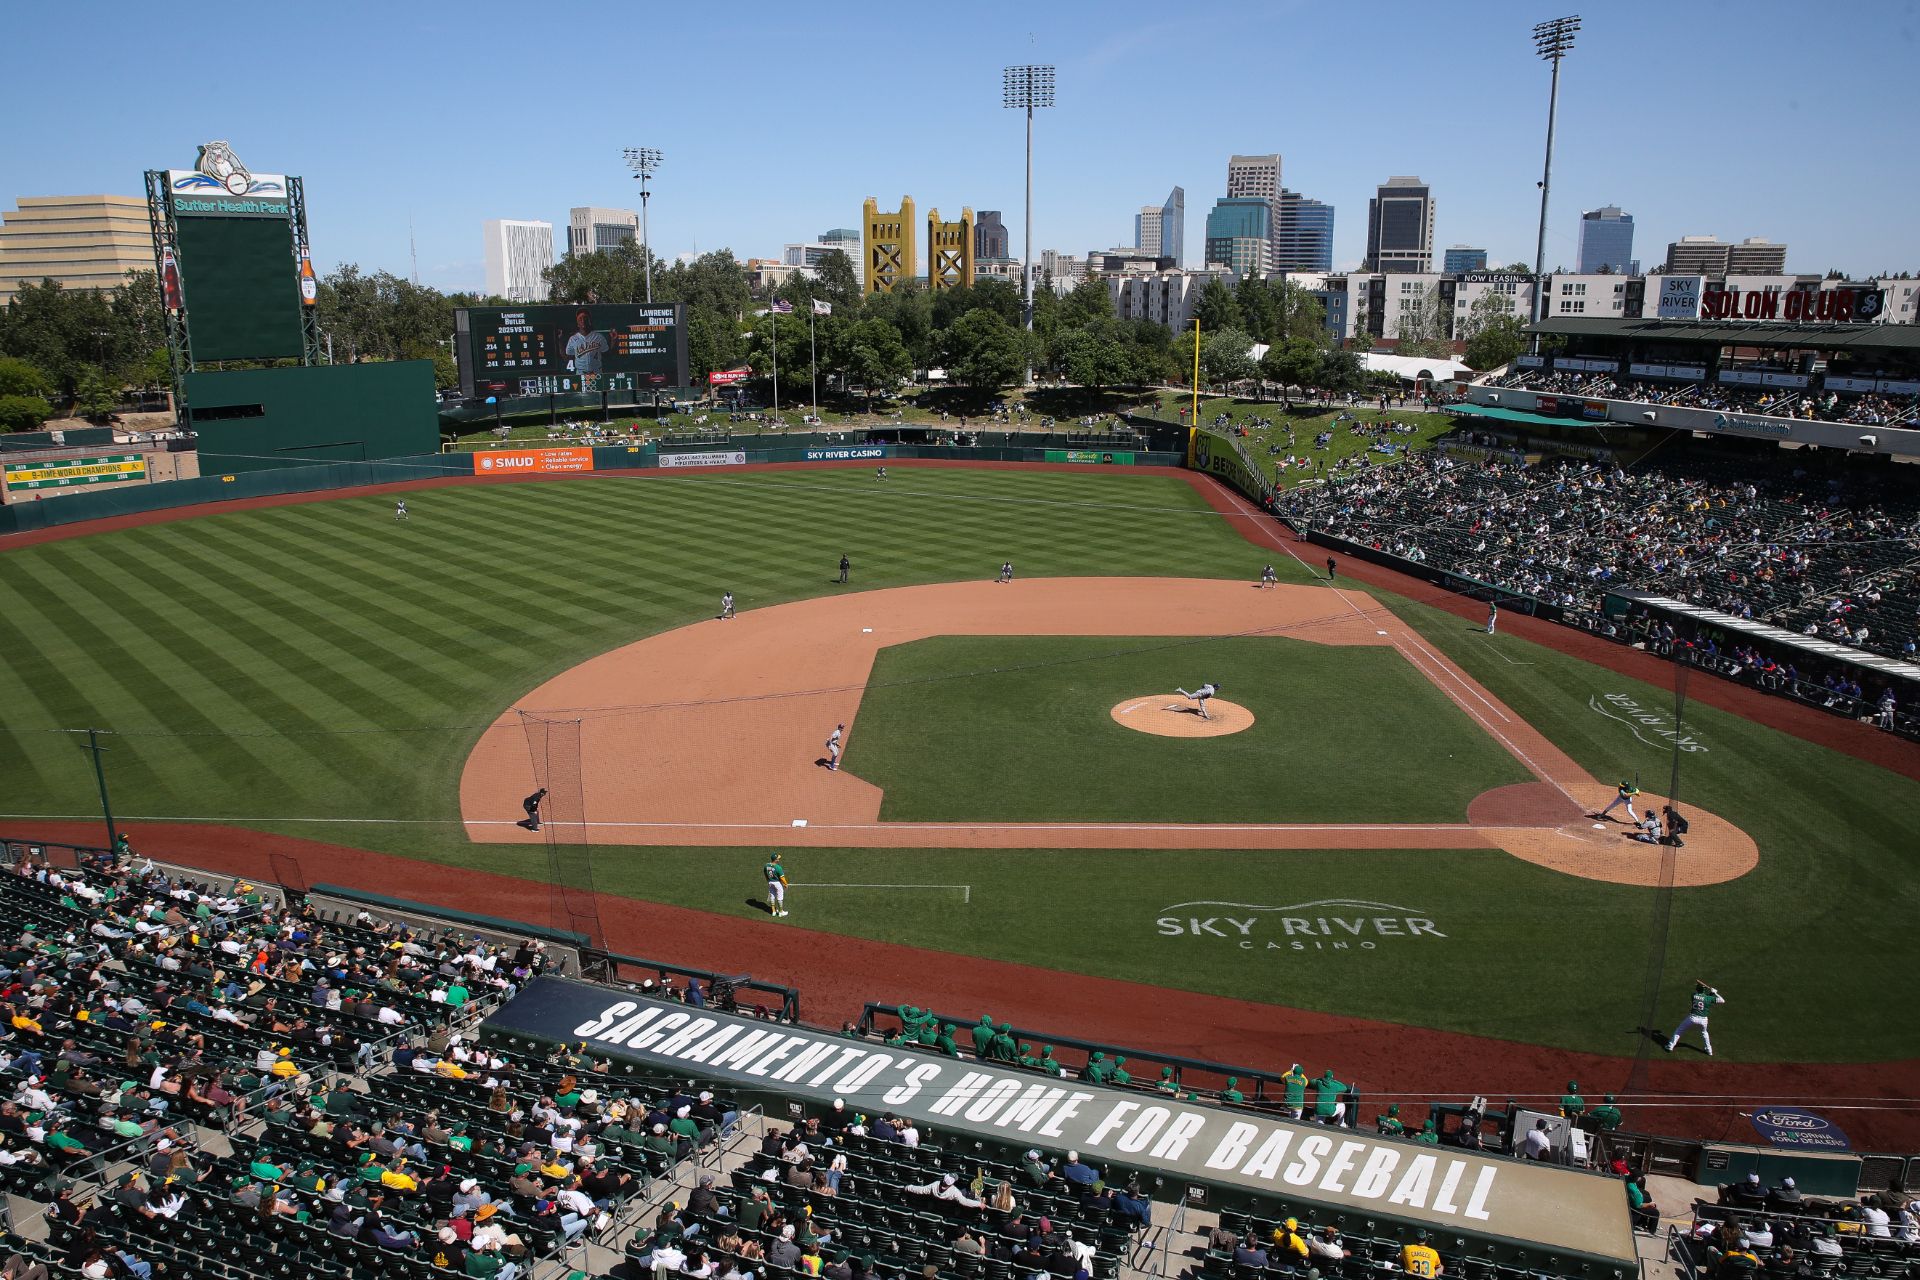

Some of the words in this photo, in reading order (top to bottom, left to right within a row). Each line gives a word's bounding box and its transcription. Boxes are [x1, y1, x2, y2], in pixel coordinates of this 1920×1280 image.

[174, 199, 216, 213] Sutter
[219, 200, 260, 213] Health
[260, 201, 289, 214] Park
[1464, 274, 1486, 283] NOW
[1669, 280, 1692, 292] SKY
[1661, 296, 1695, 309] RIVER
[1700, 290, 1780, 321] SOLON
[639, 308, 674, 317] LAWRENCE
[649, 317, 674, 326] BUTLER
[566, 360, 575, 372] 4
[563, 379, 570, 390] 8
[610, 382, 616, 391] 2
[626, 381, 632, 390] 1
[850, 449, 882, 458] CASINO
[496, 457, 534, 468] SMUD
[56, 468, 81, 477] WORLD
[82, 464, 122, 475] CHAMPIONS
[1603, 693, 1667, 725] RIVER
[1156, 917, 1258, 937] SKY
[1281, 917, 1449, 938] RIVER
[1239, 941, 1377, 950] CASINO
[573, 1000, 941, 1106] SACRAMENTO'S
[927, 1071, 1094, 1138] HOME
[1085, 1100, 1207, 1162] FOR
[1204, 1121, 1498, 1222] BASEBALL
[1772, 1115, 1815, 1128] Ford
[1774, 1131, 1834, 1140] CAFORNIA
[1800, 1138, 1846, 1147] DEALERS
[1412, 1260, 1430, 1275] 33
